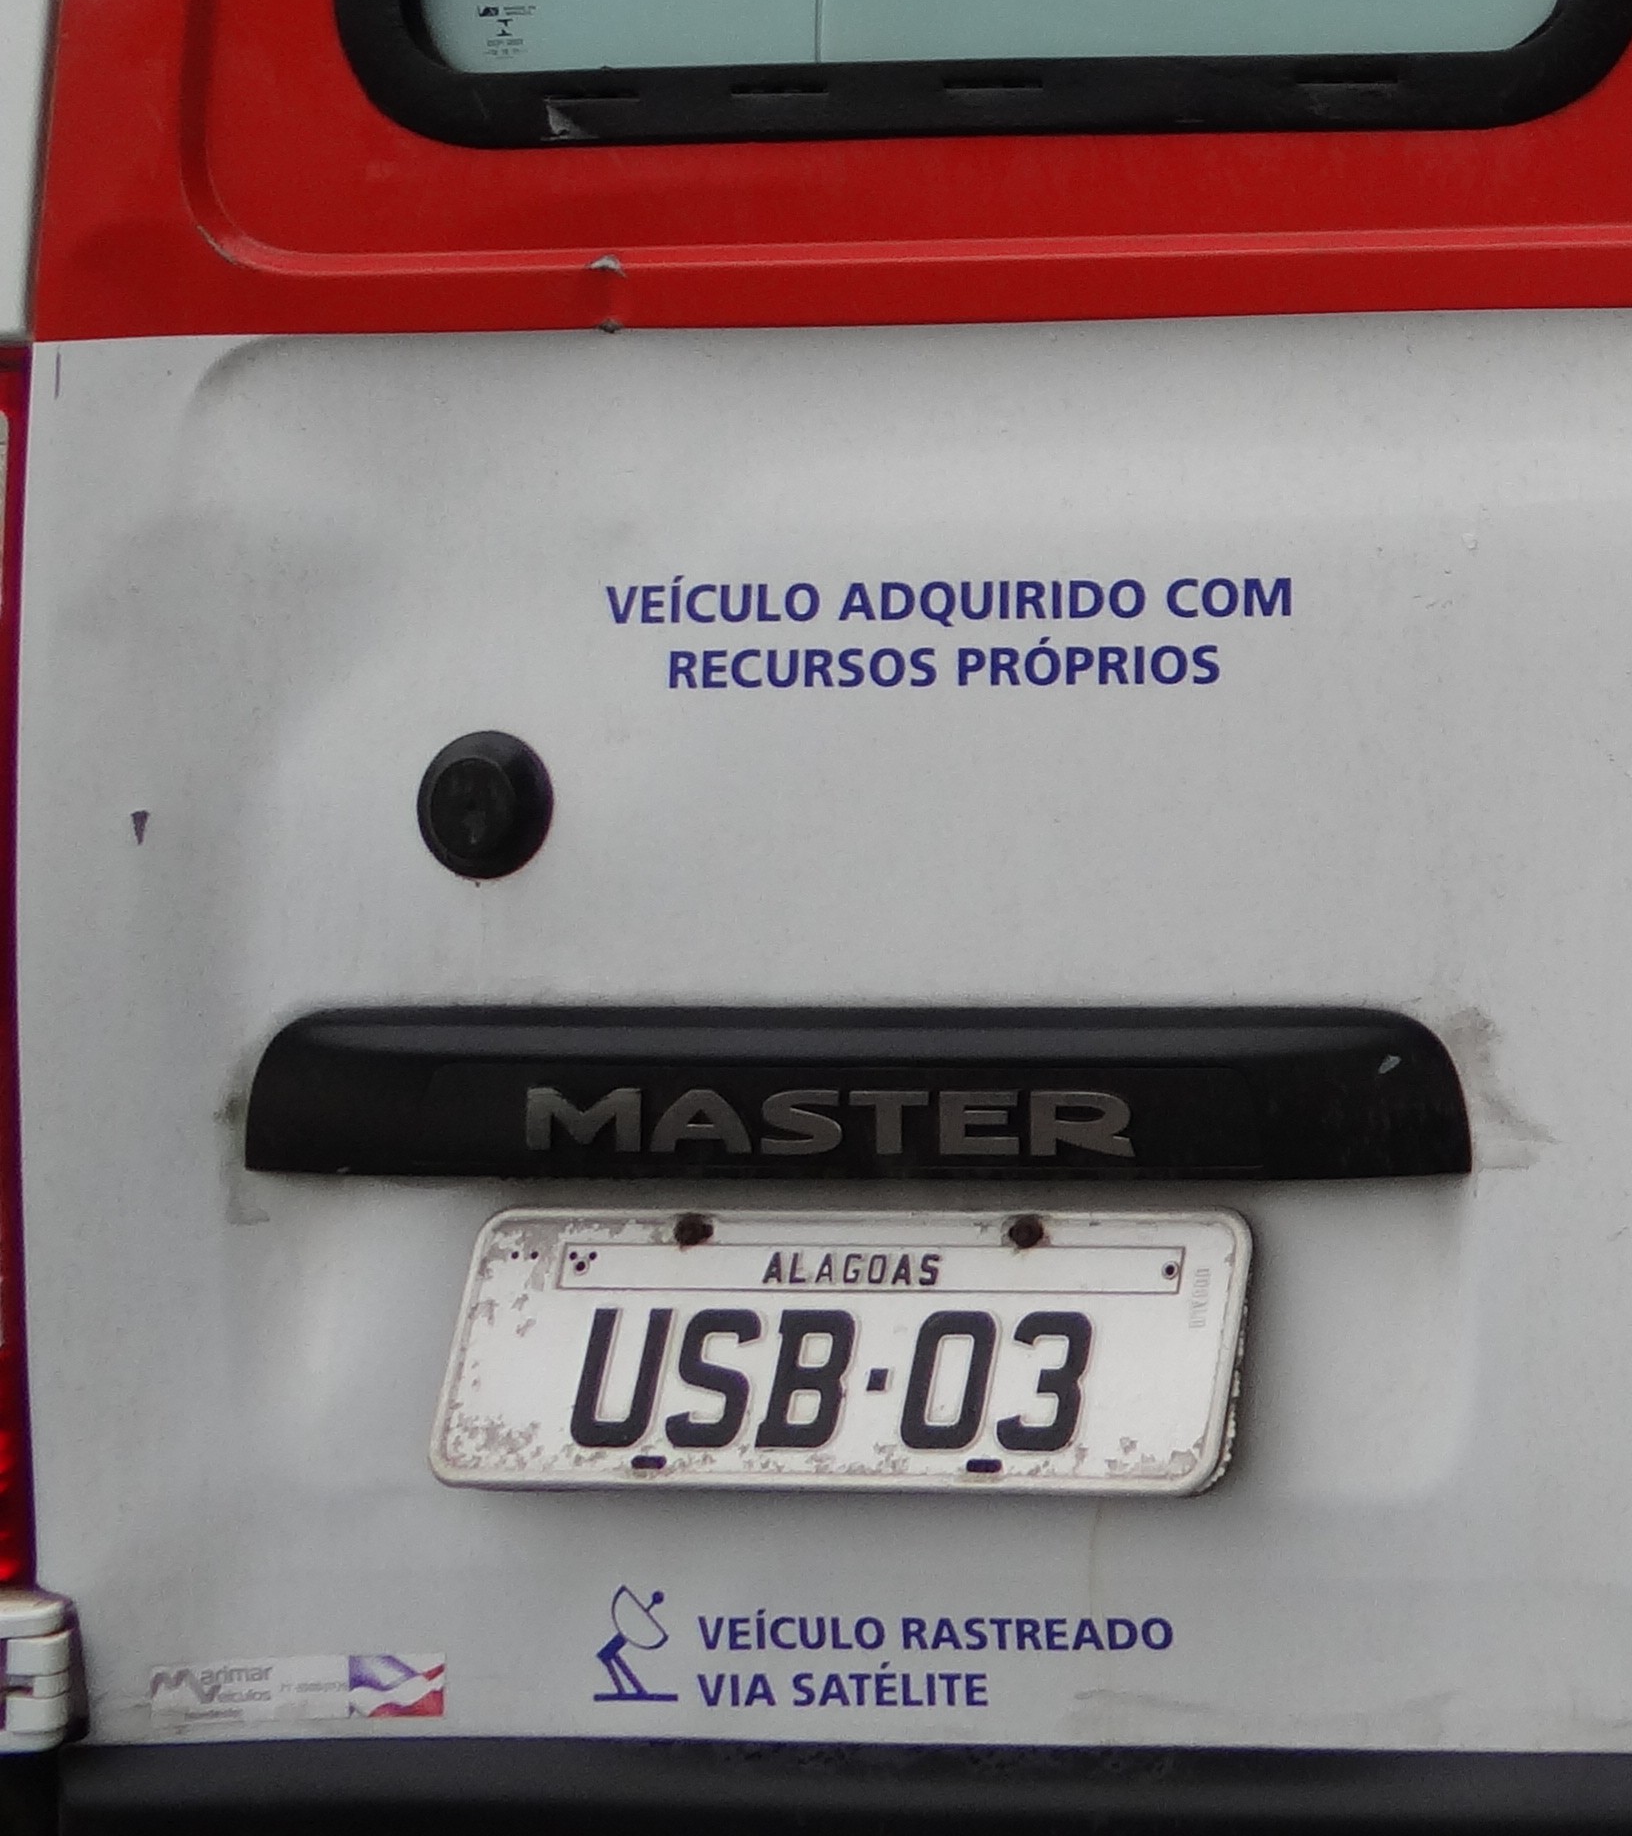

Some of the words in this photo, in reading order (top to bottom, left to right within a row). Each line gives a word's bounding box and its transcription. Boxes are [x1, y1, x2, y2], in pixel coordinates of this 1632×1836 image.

[606, 575, 821, 625] VEÍCULO
[838, 579, 1147, 627] ADQUIRIDO
[1166, 577, 1294, 619] COM
[667, 647, 938, 690] RECURSOS
[956, 637, 1221, 688] PRÓPRIOS
[524, 1085, 1136, 1160] MASTER
[761, 1251, 943, 1289] ALAGOAS
[699, 1608, 886, 1652] VEÍCULO
[901, 1615, 1174, 1652] RASTREADO
[697, 1671, 777, 1708] VIA
[791, 1661, 990, 1709] SATÉLITE
